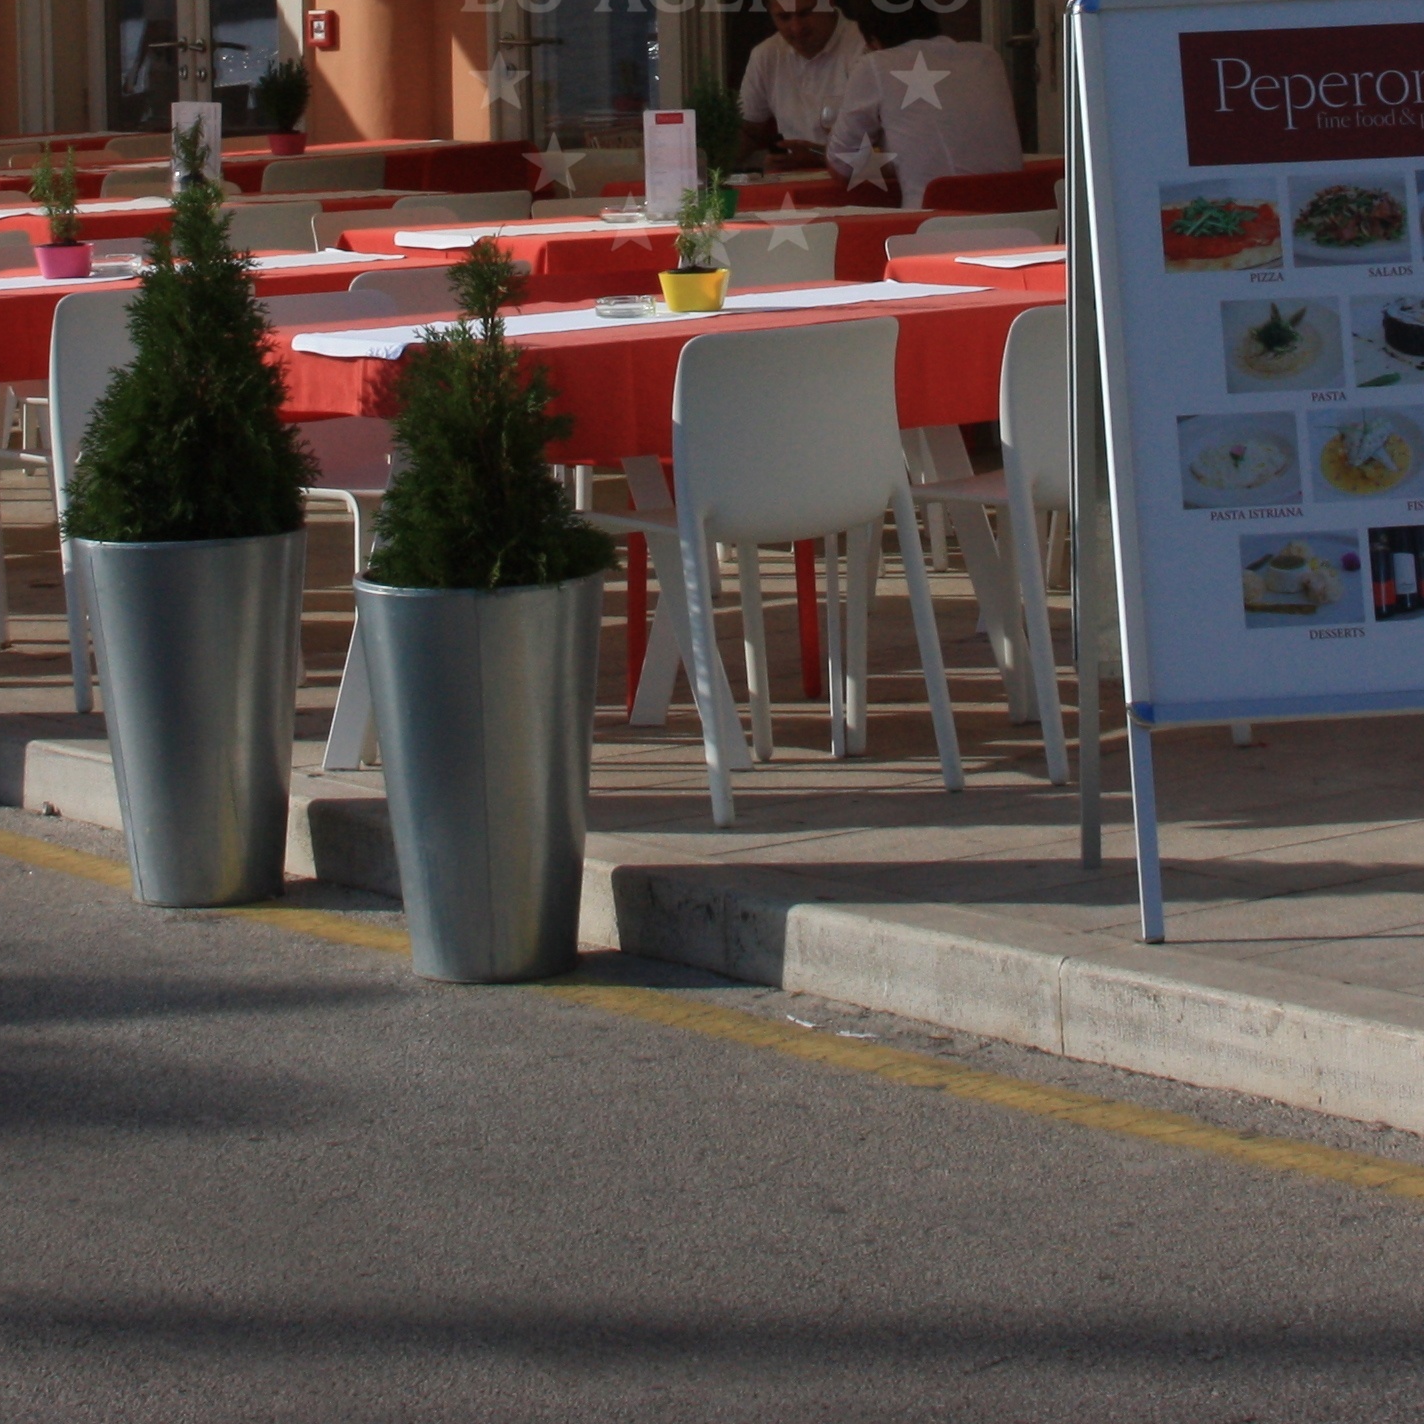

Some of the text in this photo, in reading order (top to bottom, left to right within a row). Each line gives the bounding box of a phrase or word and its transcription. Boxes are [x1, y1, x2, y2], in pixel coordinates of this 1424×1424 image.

[1316, 111, 1350, 129] fine
[1356, 109, 1396, 127] food
[1398, 107, 1416, 126] &
[1249, 271, 1284, 283] PIZZA
[1368, 265, 1414, 278] SALADS
[1311, 391, 1347, 402] PASTA
[1210, 506, 1304, 521] PASTA ISTRIANA
[1309, 627, 1366, 640] DESSERTS
